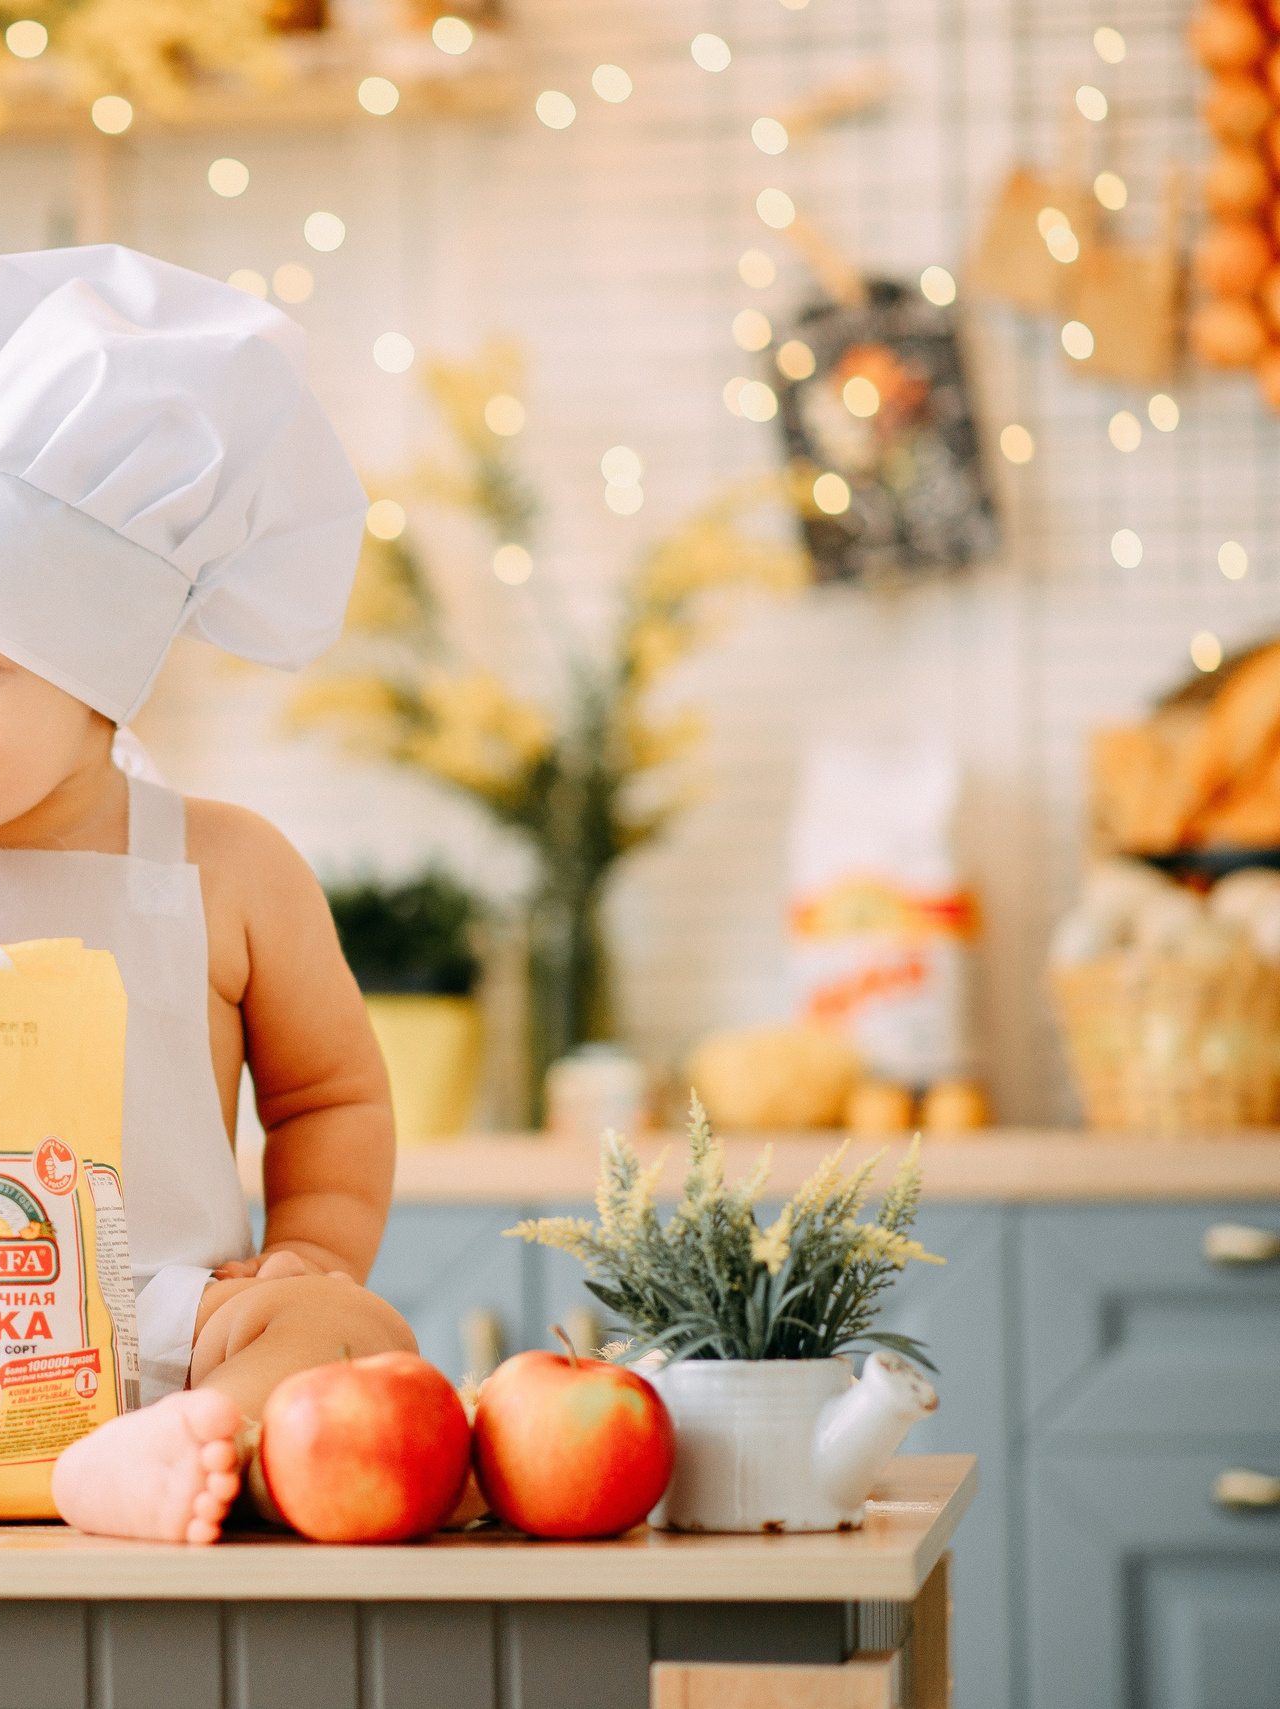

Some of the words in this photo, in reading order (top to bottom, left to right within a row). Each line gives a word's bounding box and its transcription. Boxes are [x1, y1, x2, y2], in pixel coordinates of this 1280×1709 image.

[14, 1192, 35, 1213] ГОДУ
[5, 1345, 37, 1354] СОРТ
[5, 1366, 27, 1375] Более
[82, 1372, 90, 1389] 1
